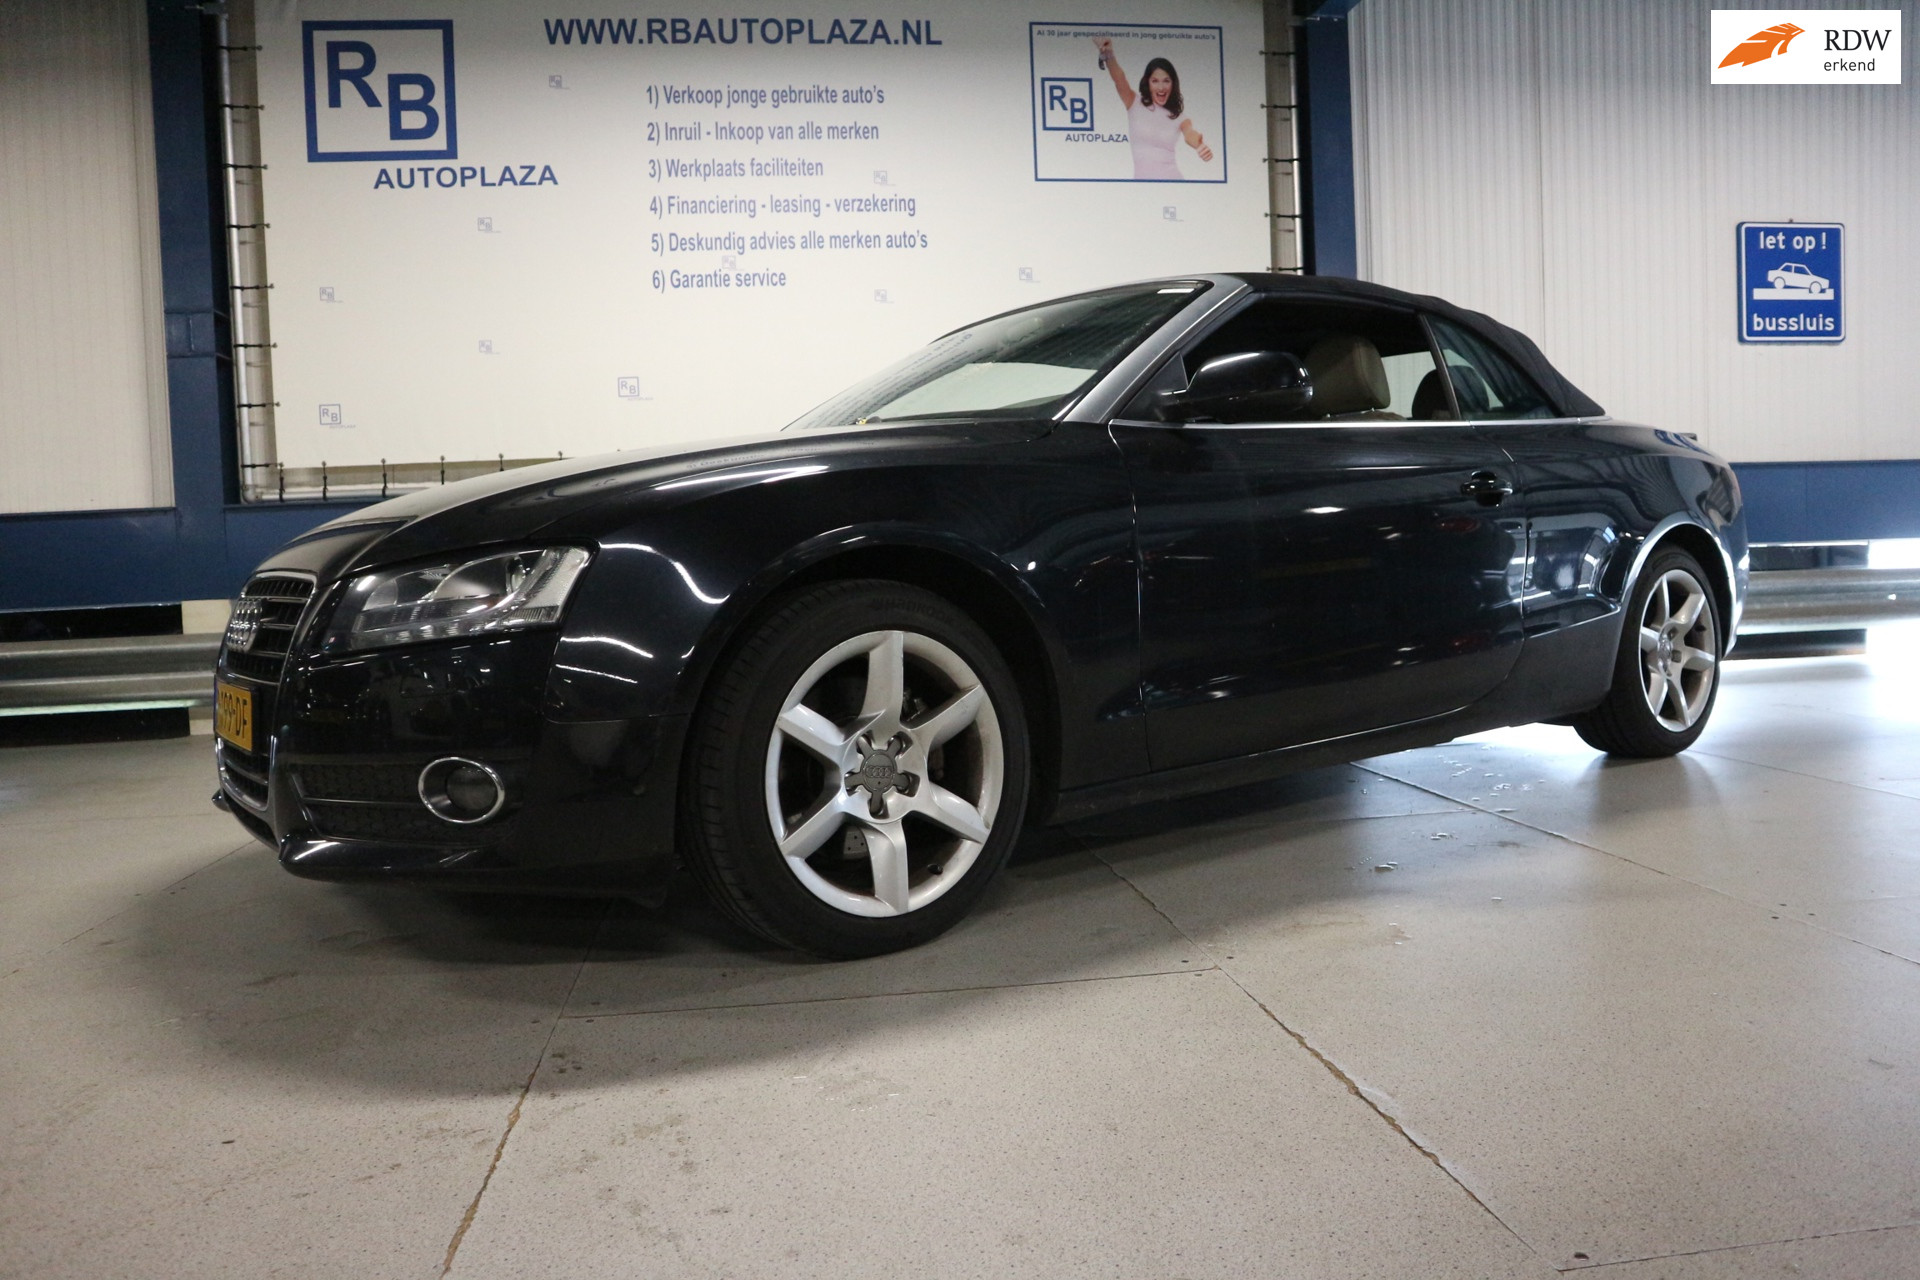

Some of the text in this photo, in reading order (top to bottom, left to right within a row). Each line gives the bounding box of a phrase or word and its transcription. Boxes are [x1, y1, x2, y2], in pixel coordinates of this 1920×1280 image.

[543, 18, 942, 46] WWW.RBAUTOPLAZA.NL
[1057, 30, 1071, 38] jaar
[1159, 32, 1192, 40] gebruikte
[325, 40, 440, 141] RB
[646, 84, 659, 109] 1)
[663, 84, 723, 109] Verkoop
[726, 84, 767, 109] jonge
[771, 84, 838, 109] gebruikte
[1049, 85, 1088, 124] RB
[647, 122, 660, 146] 2)
[665, 121, 701, 141] Inruil
[715, 121, 764, 144] Inkoop
[768, 125, 793, 140] van
[798, 121, 822, 140] alle
[827, 121, 879, 140] merken
[1065, 133, 1129, 143] AUTOPLAZA
[374, 165, 558, 189] AUTOPLAZA
[648, 157, 823, 183] 3) Werkplaats faciliteiten
[650, 195, 662, 220] 4)
[667, 194, 756, 218] Financiering
[770, 194, 821, 217] leasing
[834, 193, 916, 217] verzekering
[651, 233, 664, 256] 5)
[669, 231, 745, 255] Deskundig
[750, 230, 795, 249] advies
[800, 230, 825, 249] alle
[829, 230, 881, 249] merken
[1760, 231, 1827, 253] let op !
[652, 267, 786, 294] 6) Garantie service
[1753, 312, 1835, 331] bussluis
